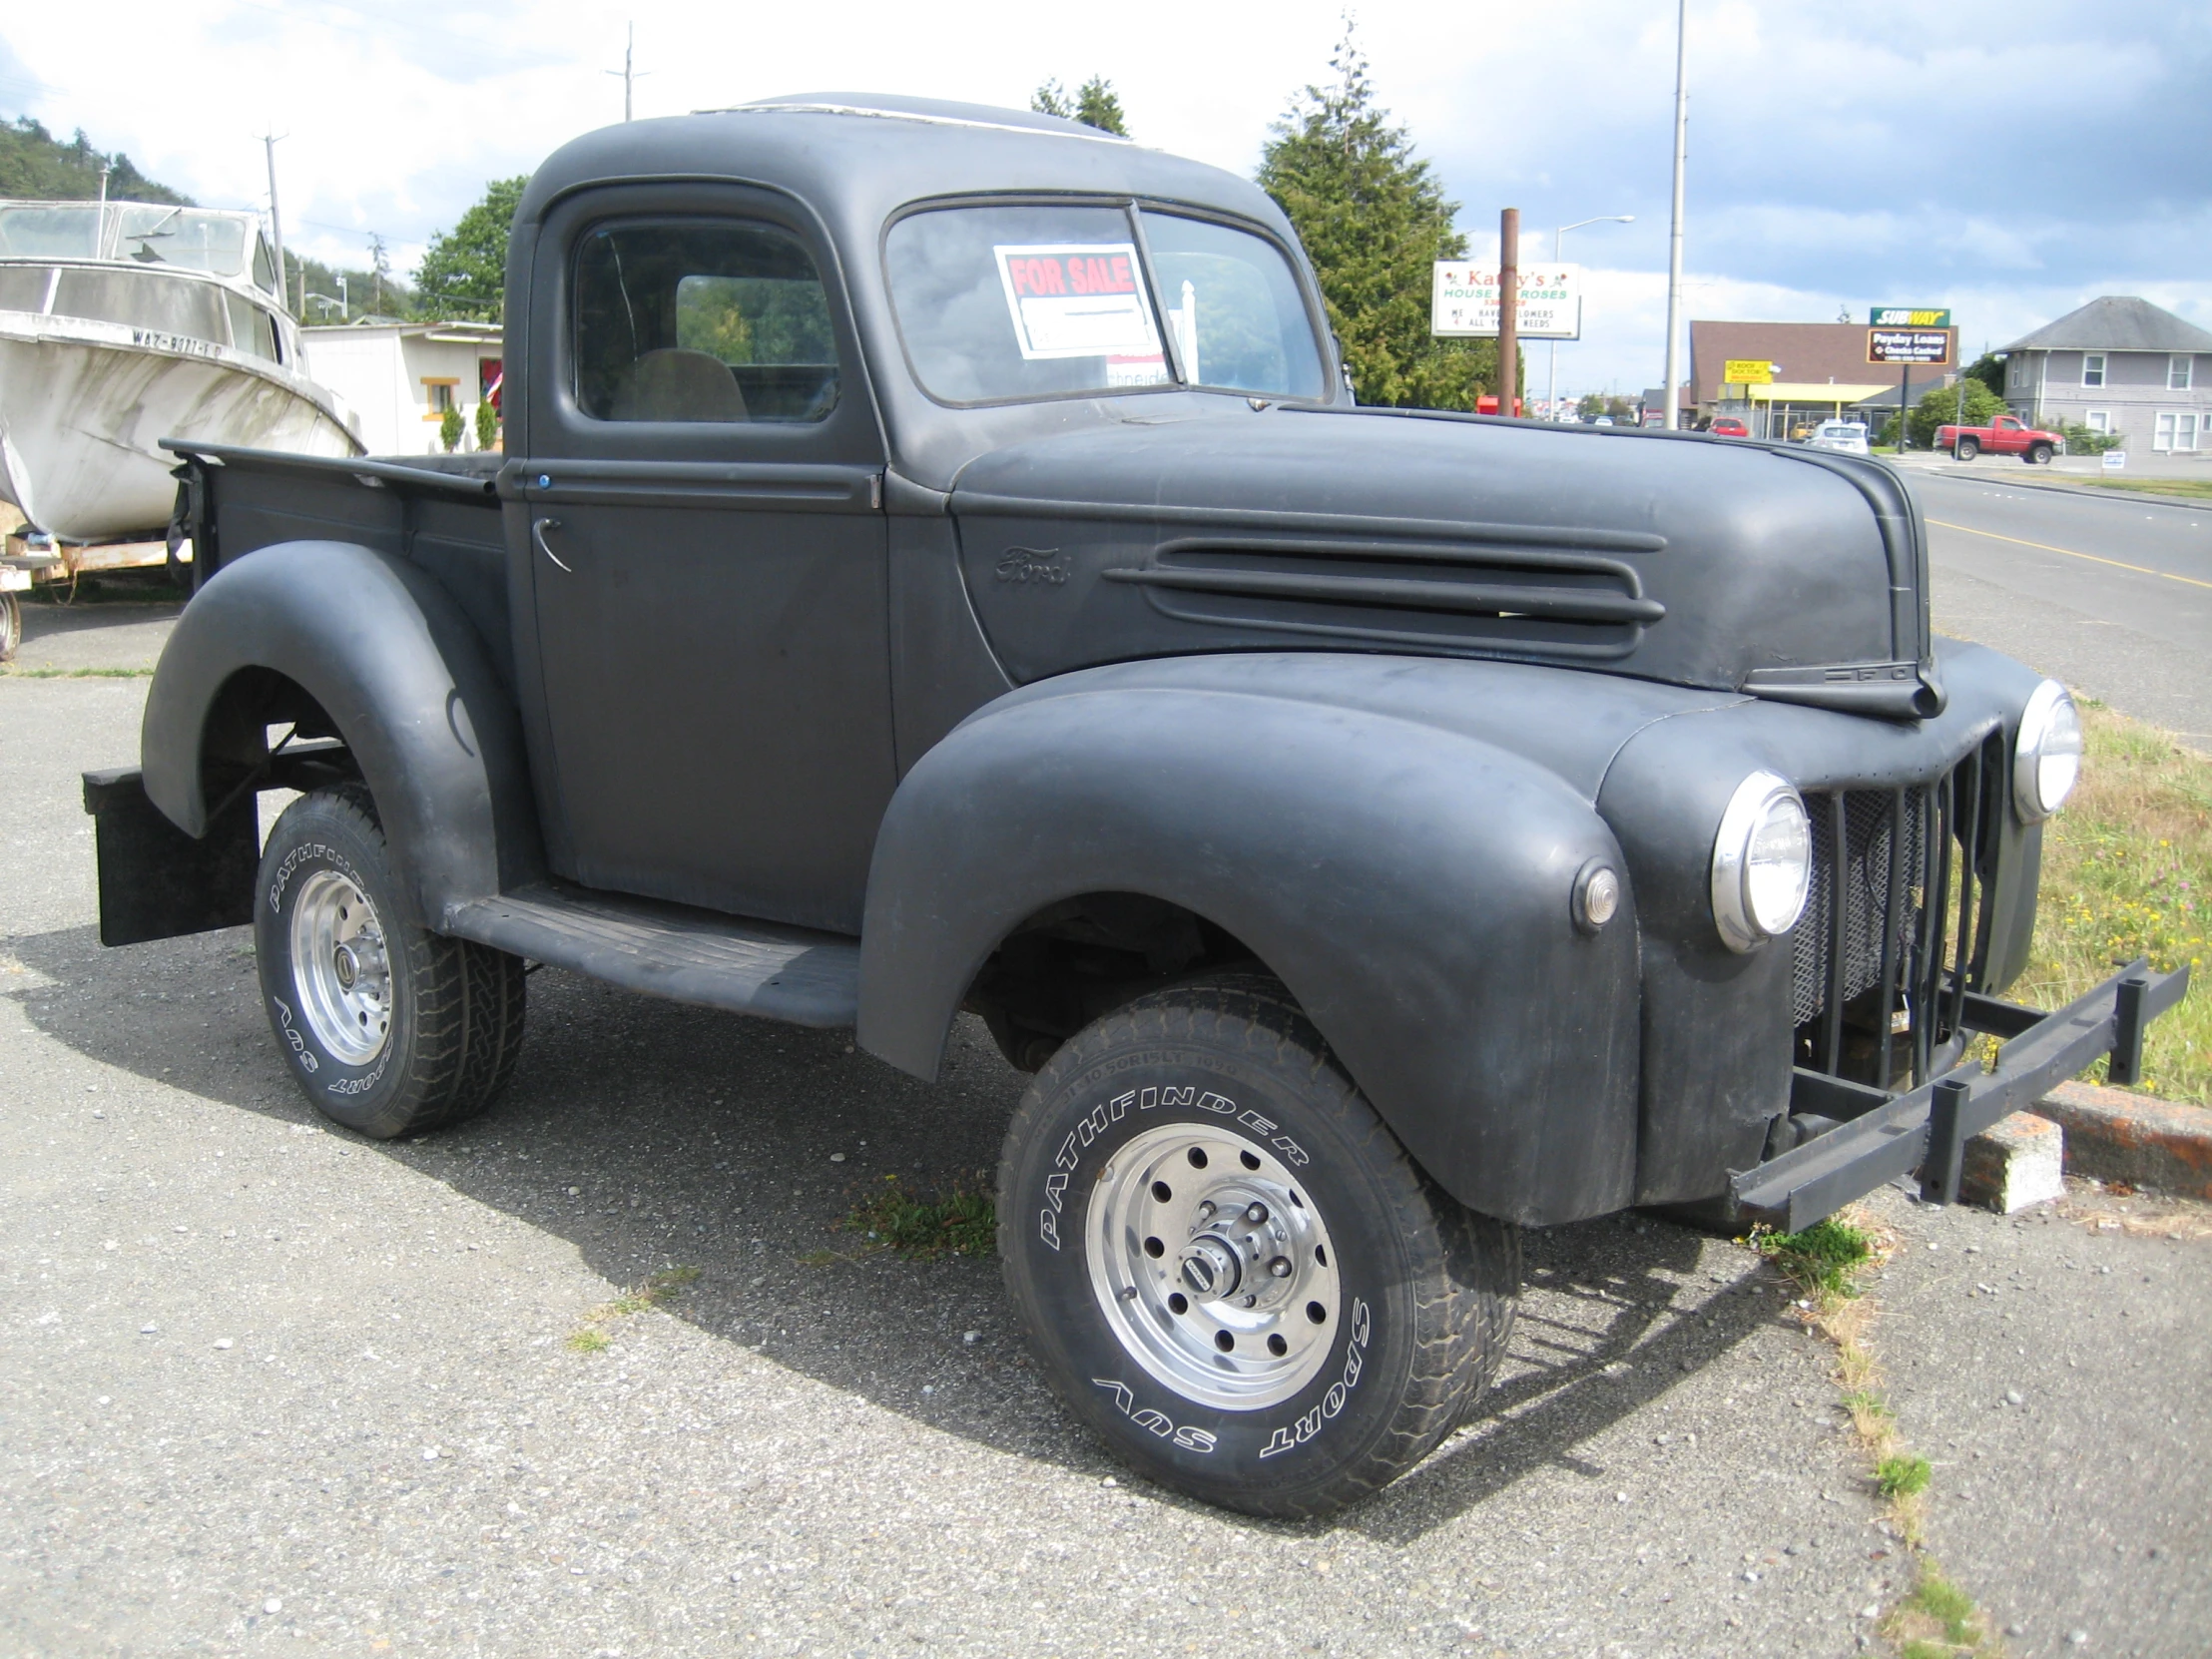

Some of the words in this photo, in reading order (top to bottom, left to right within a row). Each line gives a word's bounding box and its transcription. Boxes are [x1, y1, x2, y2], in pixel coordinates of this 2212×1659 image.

[1009, 258, 1068, 295] FOR
[1067, 256, 1135, 294] SALE
[1467, 271, 1545, 290] Katy's
[1443, 288, 1493, 298] HOUSE
[1519, 289, 1568, 300] ROSES
[1523, 319, 1550, 328] NEEDS
[1876, 309, 1944, 325] SUBWAY
[1874, 332, 1913, 346] Payday
[1914, 333, 1945, 344] Loans
[995, 546, 1073, 584] Ford
[274, 995, 318, 1073] SUV
[1040, 1086, 1310, 1251] PATHFINDER
[1188, 1261, 1209, 1290] WARN
[1259, 1297, 1371, 1458] SPORT
[1091, 1378, 1217, 1453] SUV
